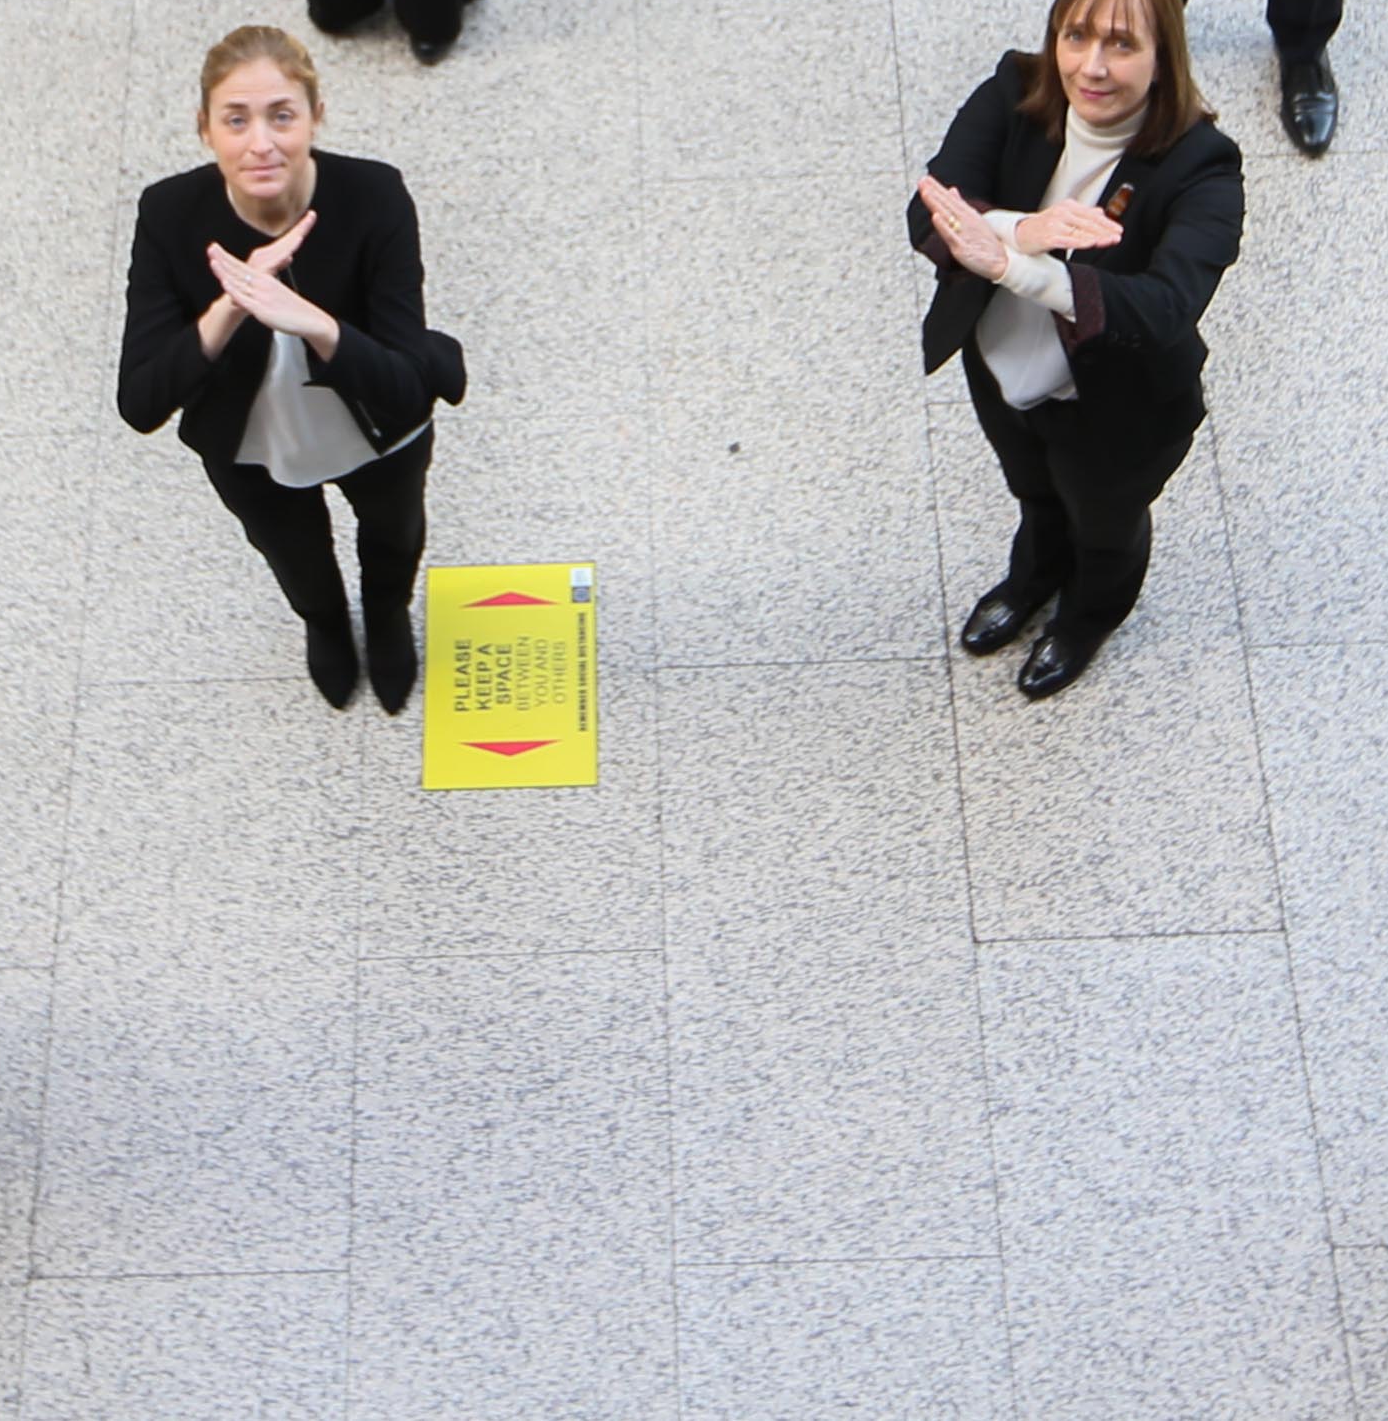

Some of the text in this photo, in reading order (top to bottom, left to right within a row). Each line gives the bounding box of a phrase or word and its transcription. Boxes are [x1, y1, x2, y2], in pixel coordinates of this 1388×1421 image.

[454, 639, 470, 712] PLEASE
[476, 642, 493, 711] KEEP A
[495, 643, 512, 705] SPACE
[516, 635, 531, 711] BETWEEN
[533, 638, 549, 708] YOU AND
[553, 640, 567, 705] OTHERS
